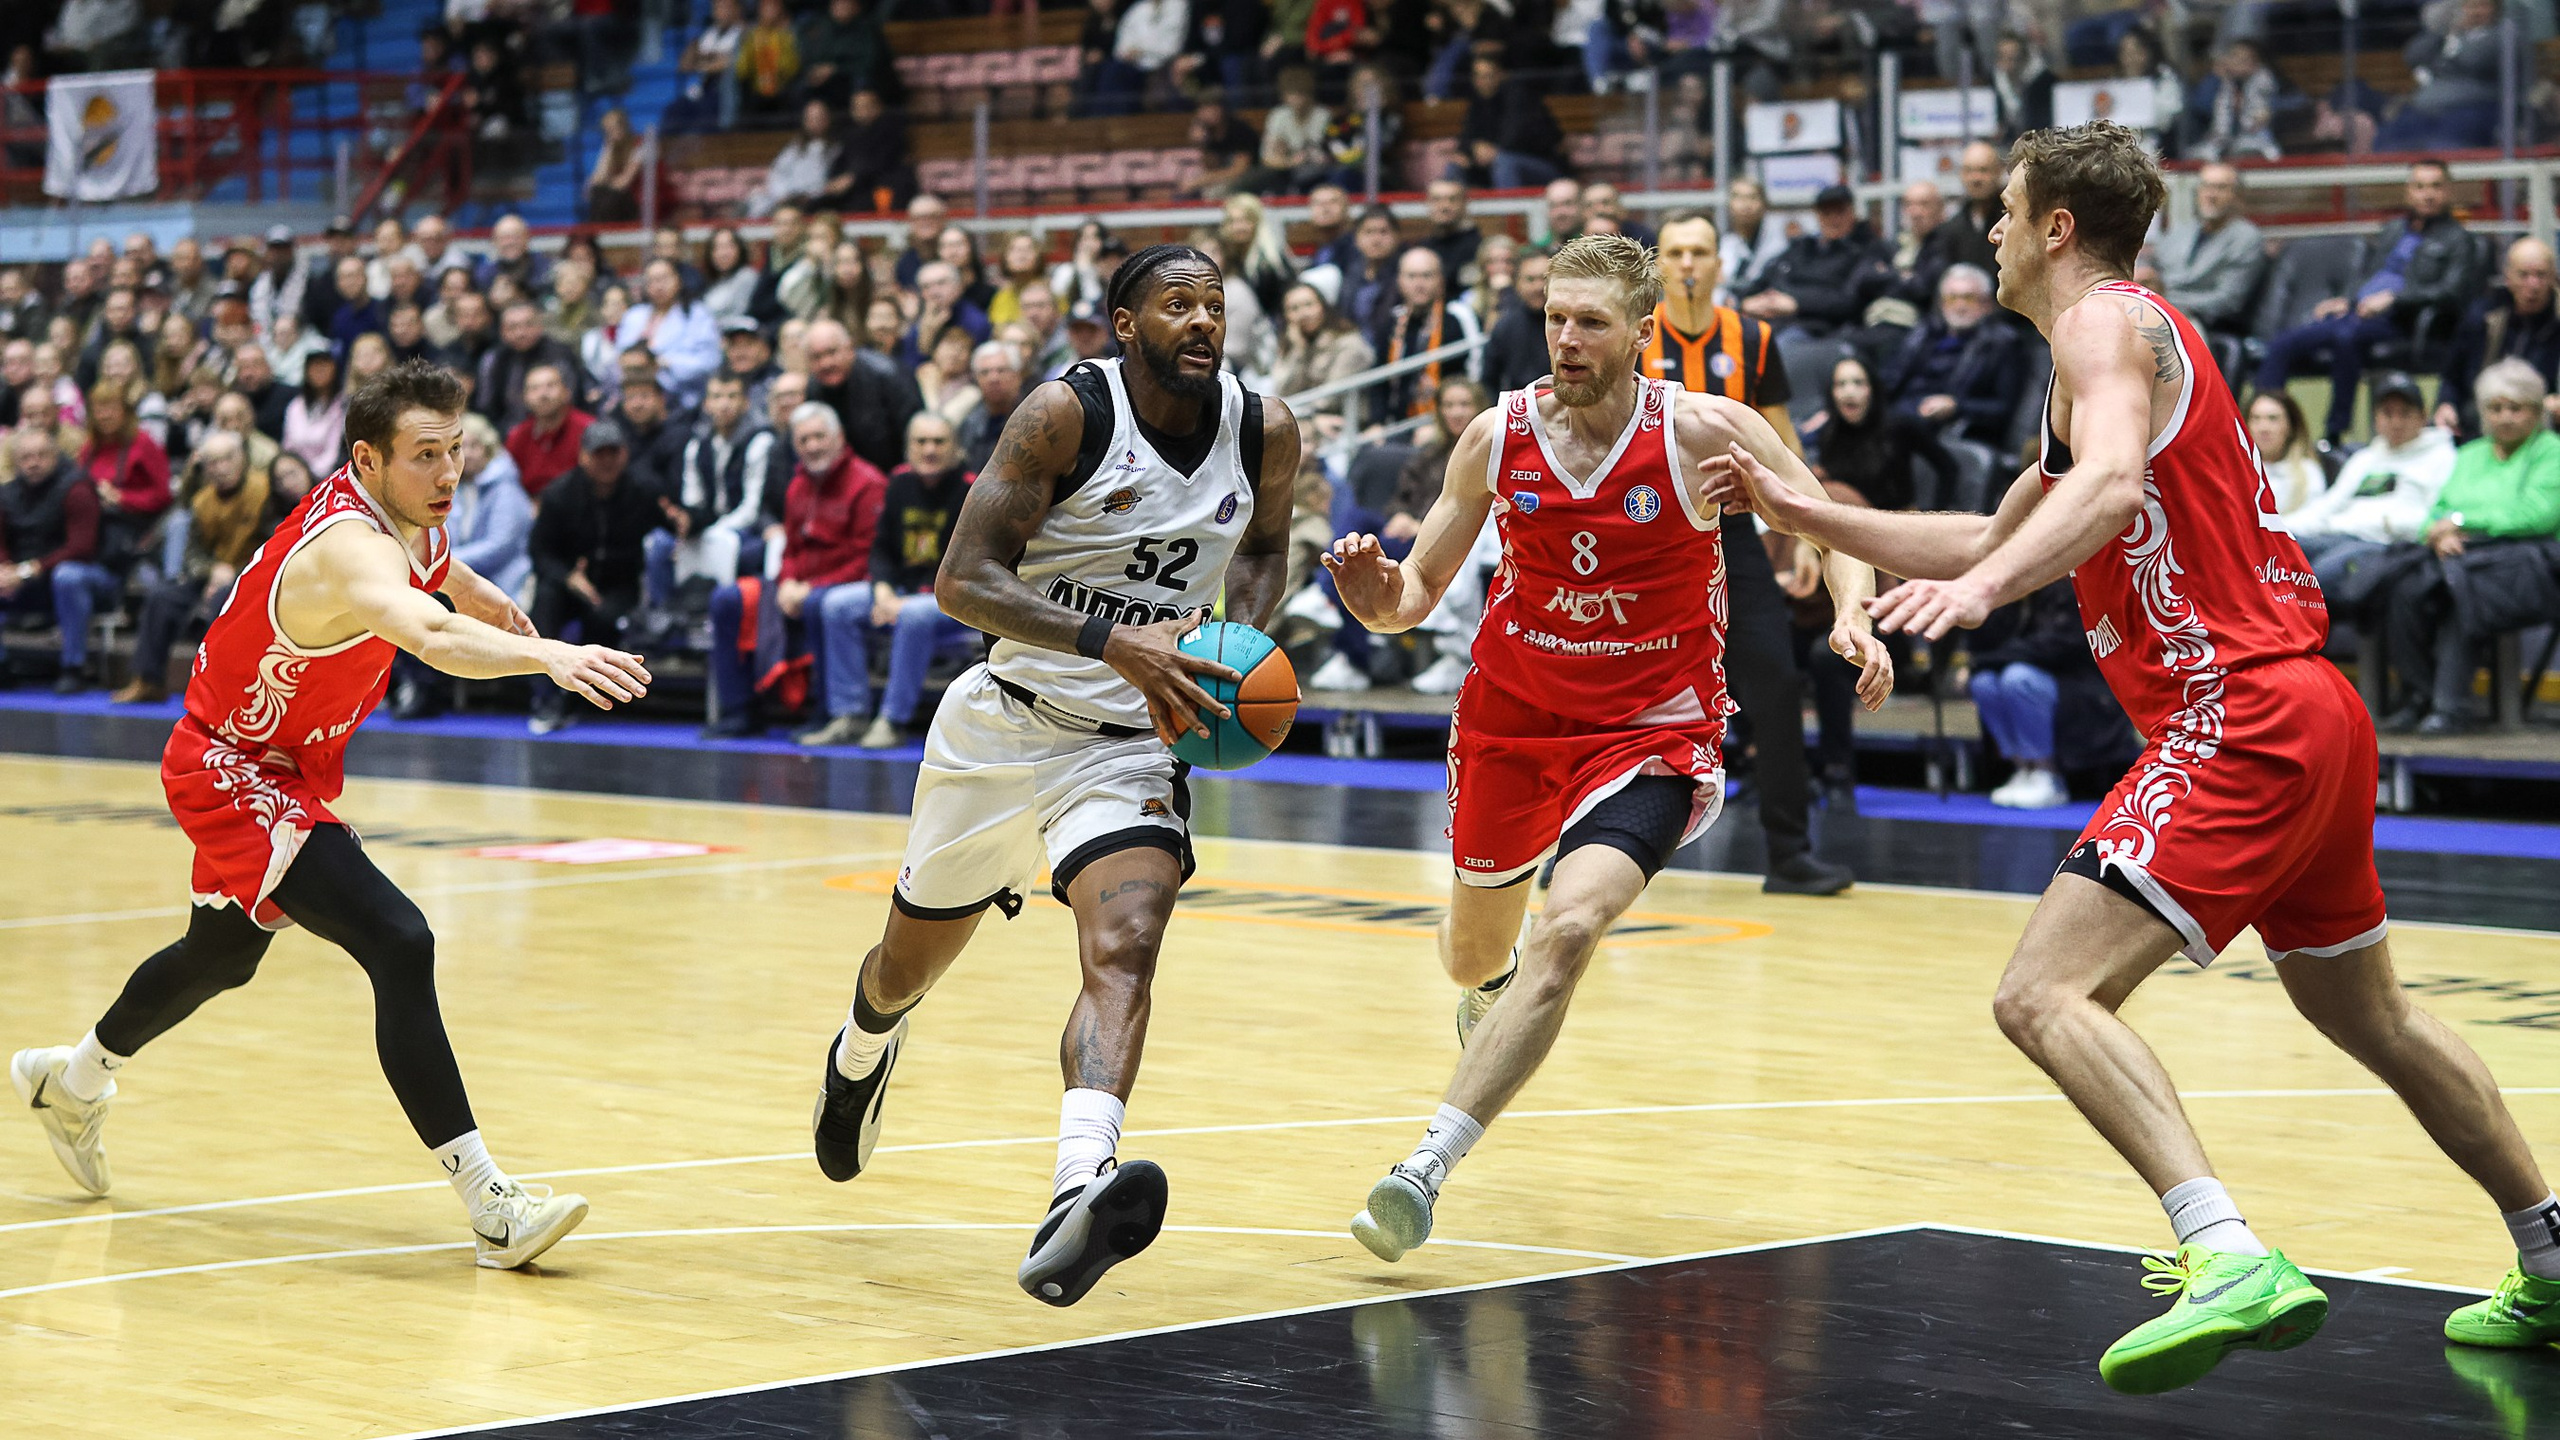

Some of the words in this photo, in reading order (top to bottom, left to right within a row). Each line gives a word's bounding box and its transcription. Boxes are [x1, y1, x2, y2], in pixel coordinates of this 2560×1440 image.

[1510, 469, 1542, 482] ZEDO
[1123, 537, 1200, 592] 52
[1570, 530, 1599, 576] 8
[1464, 855, 1495, 868] ZEDO
